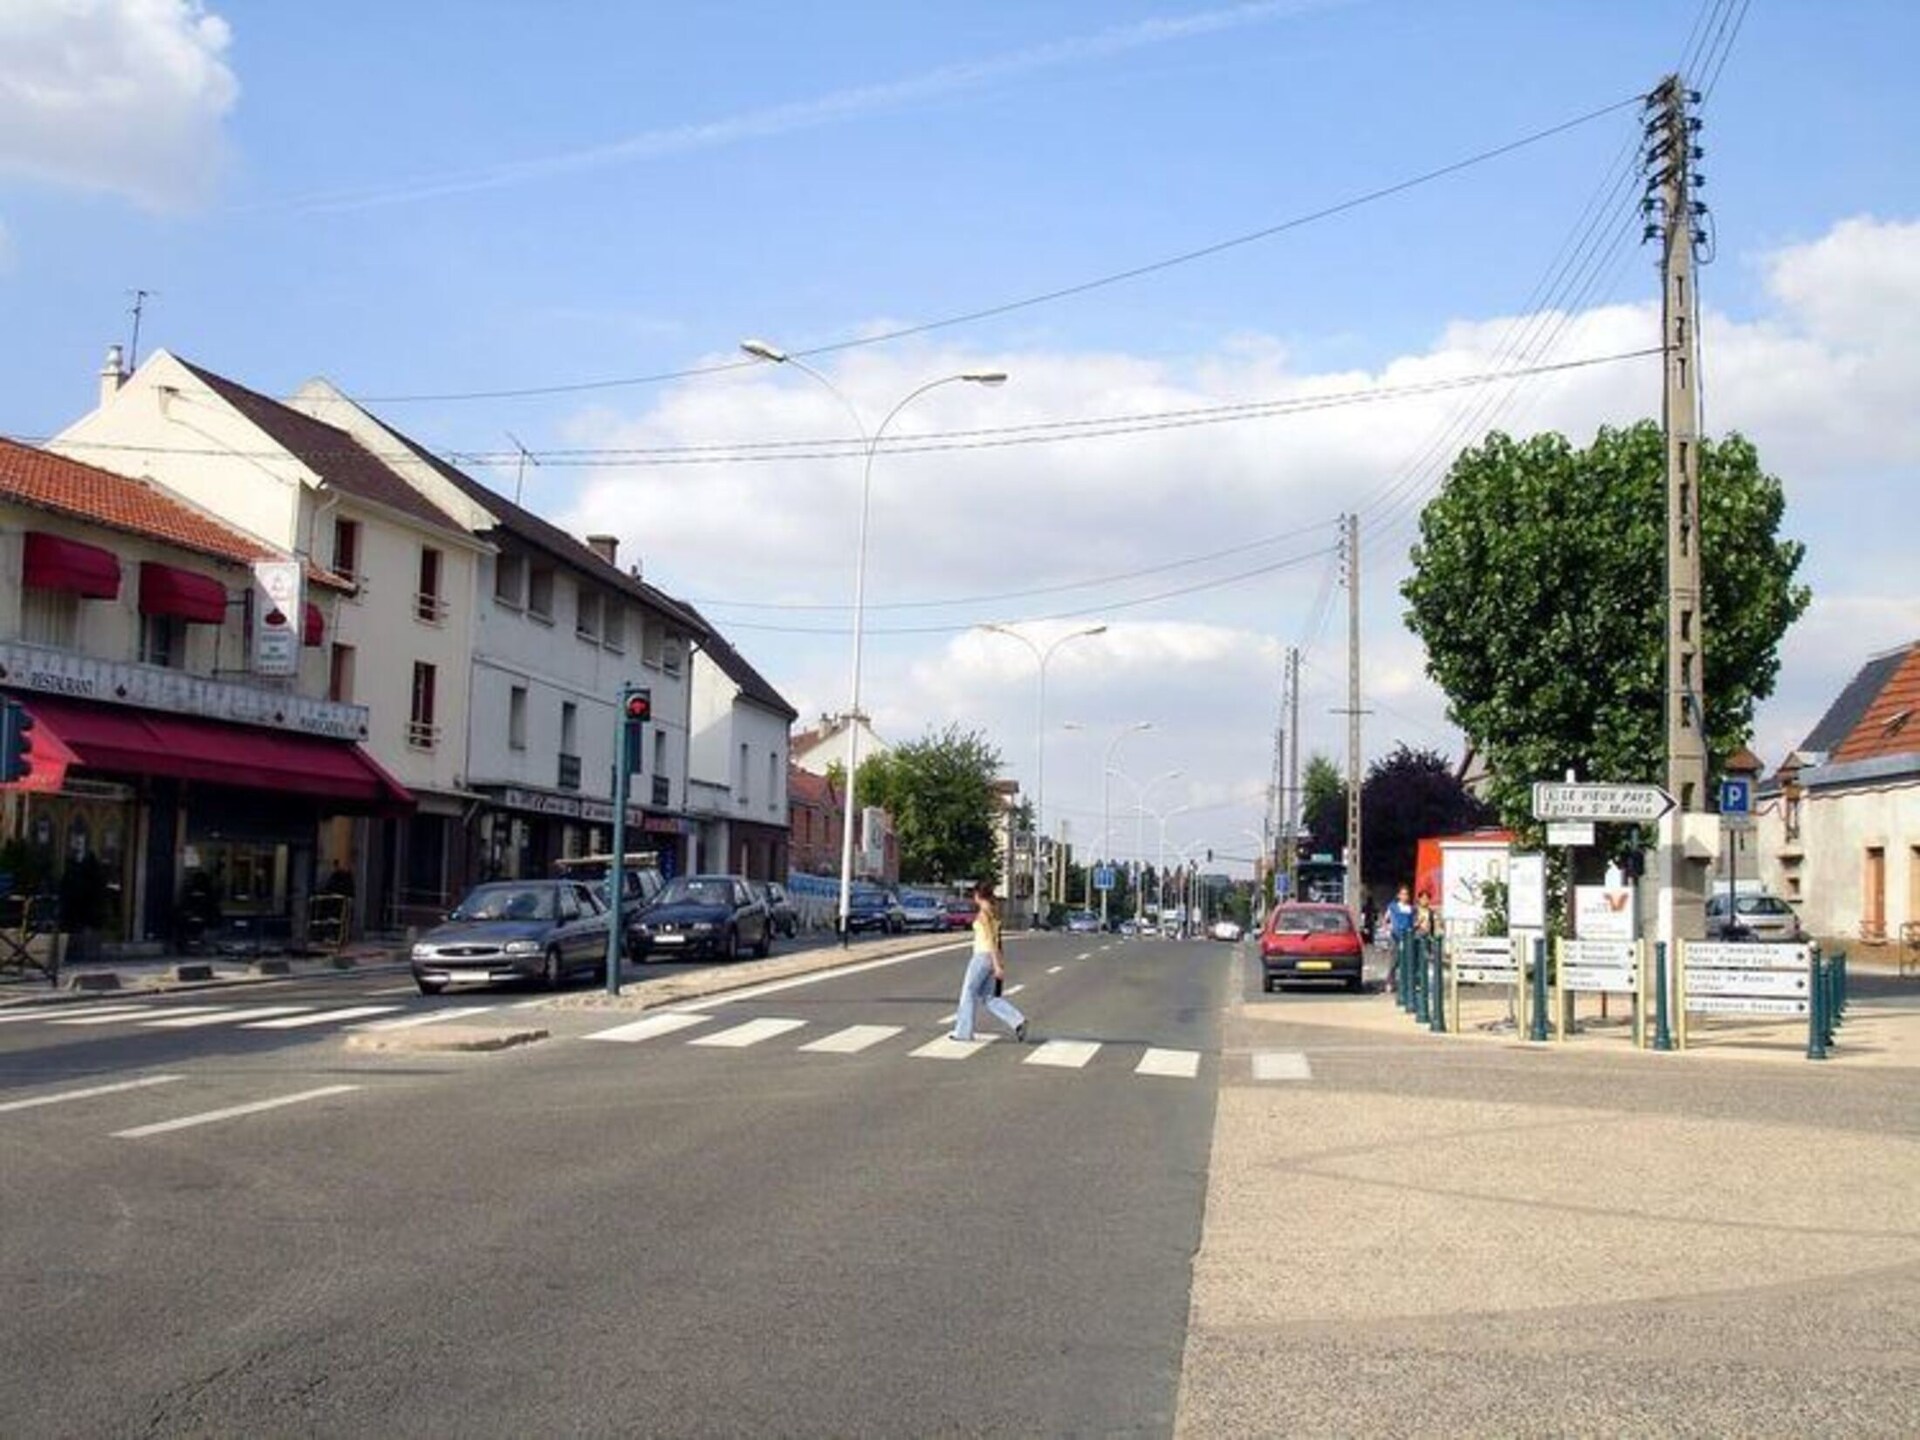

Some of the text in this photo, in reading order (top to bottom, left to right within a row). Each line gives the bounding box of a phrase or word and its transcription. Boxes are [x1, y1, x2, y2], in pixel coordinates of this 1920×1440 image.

[31, 671, 94, 696] RESTAURANT
[1562, 789, 1654, 803] LE VIEUX PAYS
[1728, 786, 1742, 807] P
